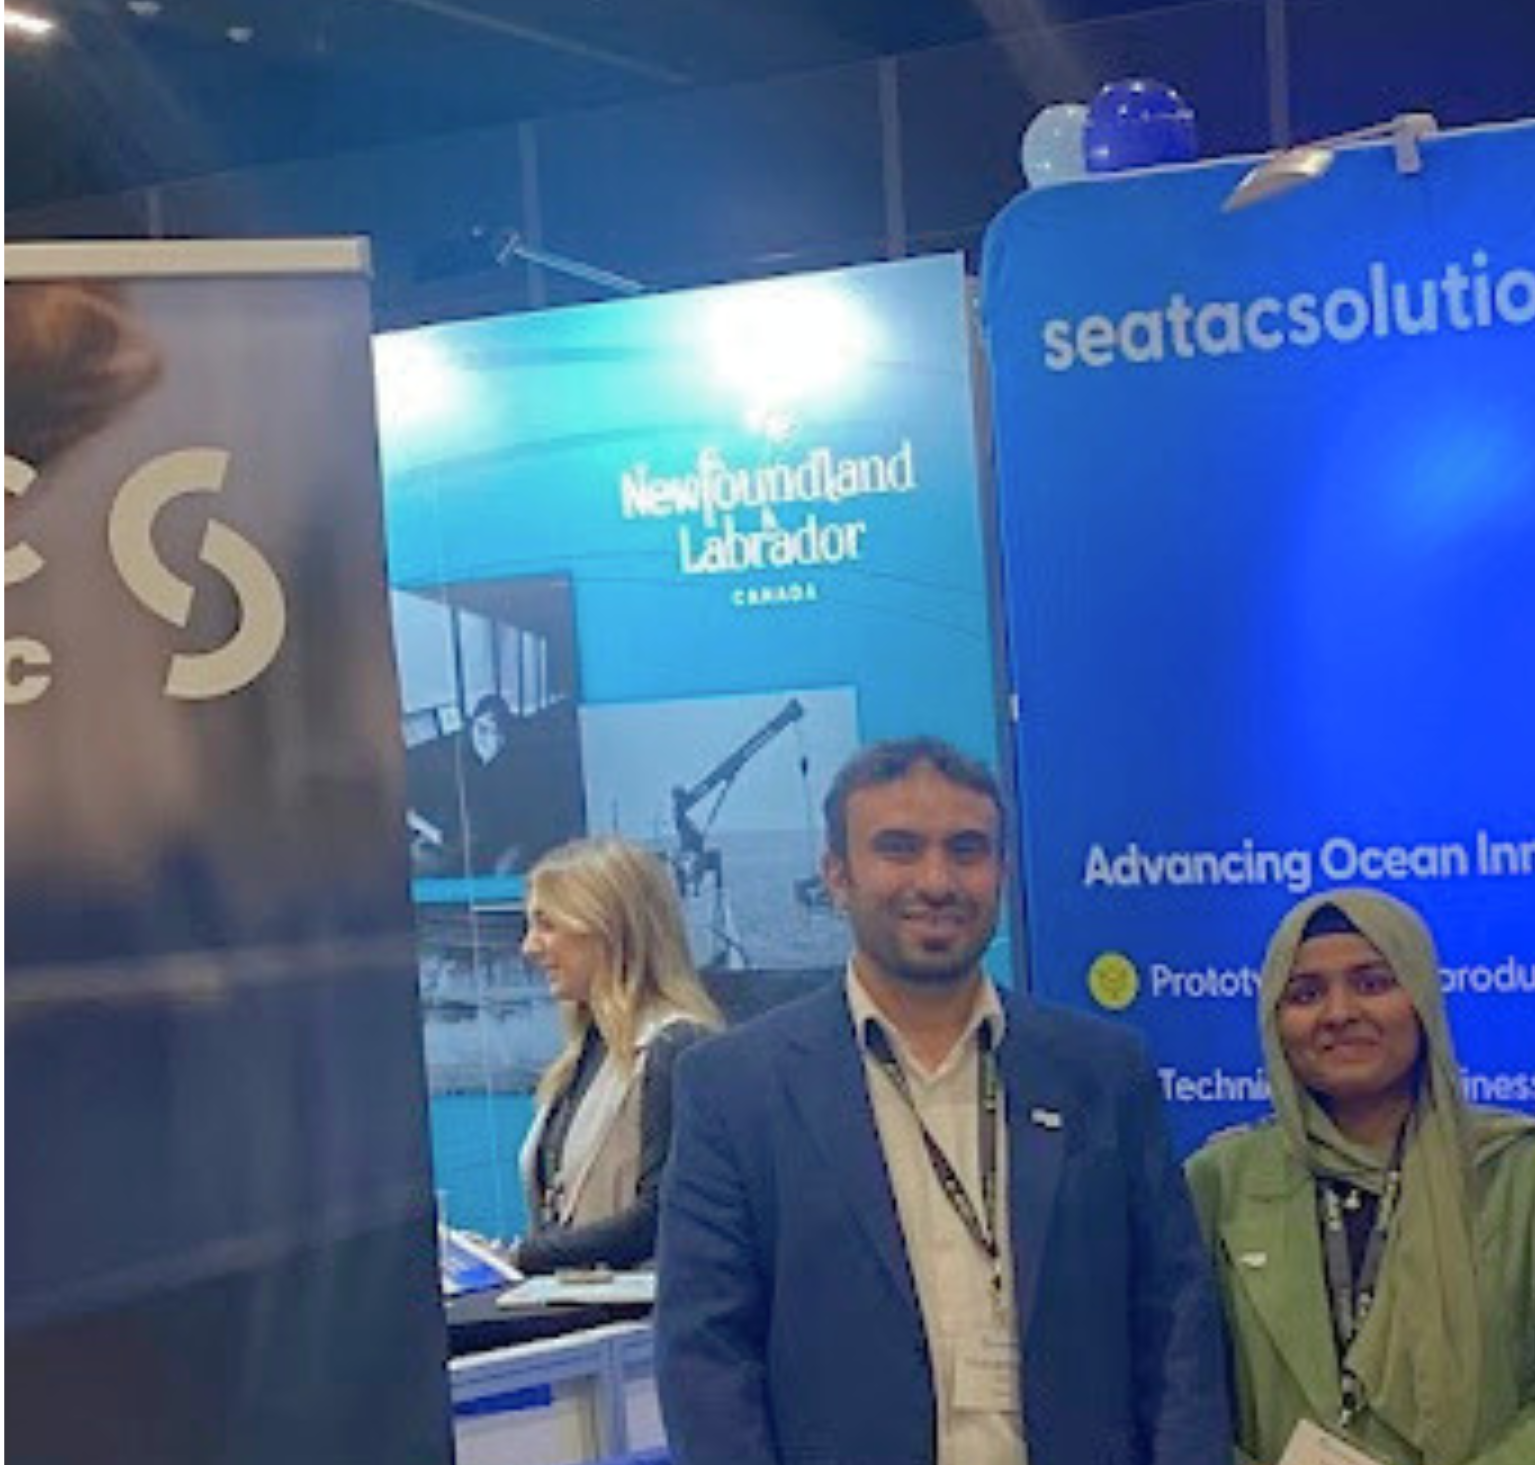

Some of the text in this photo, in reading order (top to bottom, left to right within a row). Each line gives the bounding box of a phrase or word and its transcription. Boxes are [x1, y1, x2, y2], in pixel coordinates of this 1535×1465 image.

[620, 437, 917, 529] Newfoundland
[677, 513, 866, 574] Labrador
[1084, 838, 1313, 893] Advancing
[1319, 834, 1470, 884] Ocean
